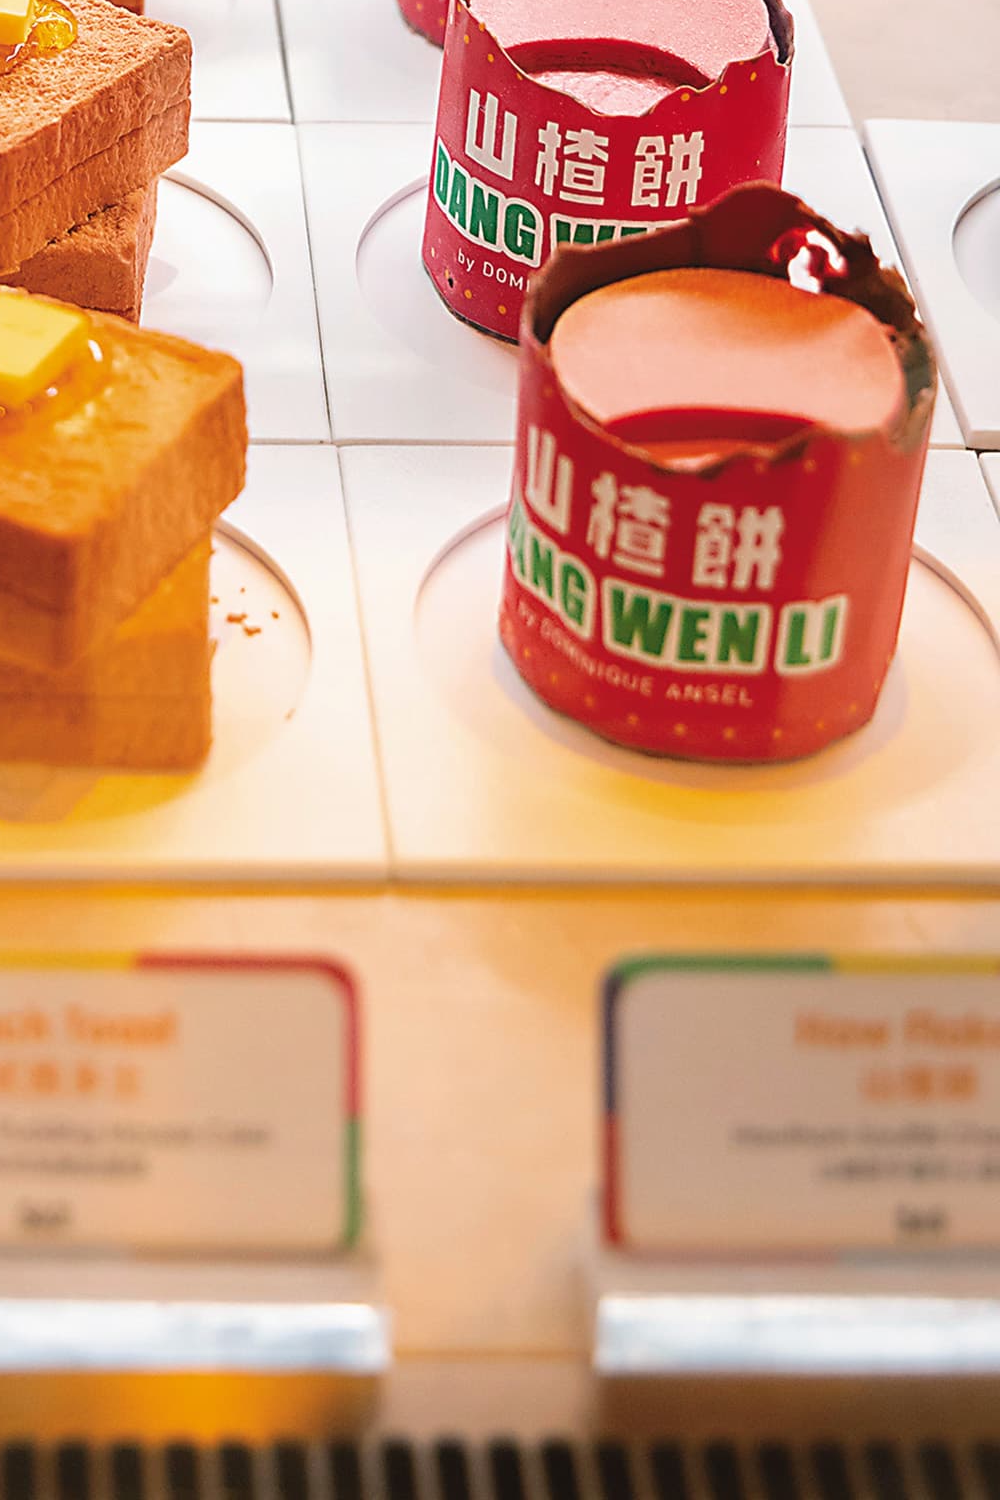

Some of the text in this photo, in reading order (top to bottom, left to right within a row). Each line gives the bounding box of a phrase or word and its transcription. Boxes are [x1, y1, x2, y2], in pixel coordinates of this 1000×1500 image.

[465, 88, 705, 208] 山楂餅
[434, 138, 542, 267] DANG
[457, 248, 475, 272] by
[525, 426, 784, 591] 山楂餅
[540, 617, 653, 696] DOMINIQUE
[665, 682, 753, 708] ANSEL
[604, 582, 767, 670] WEN
[778, 600, 844, 670] LI
